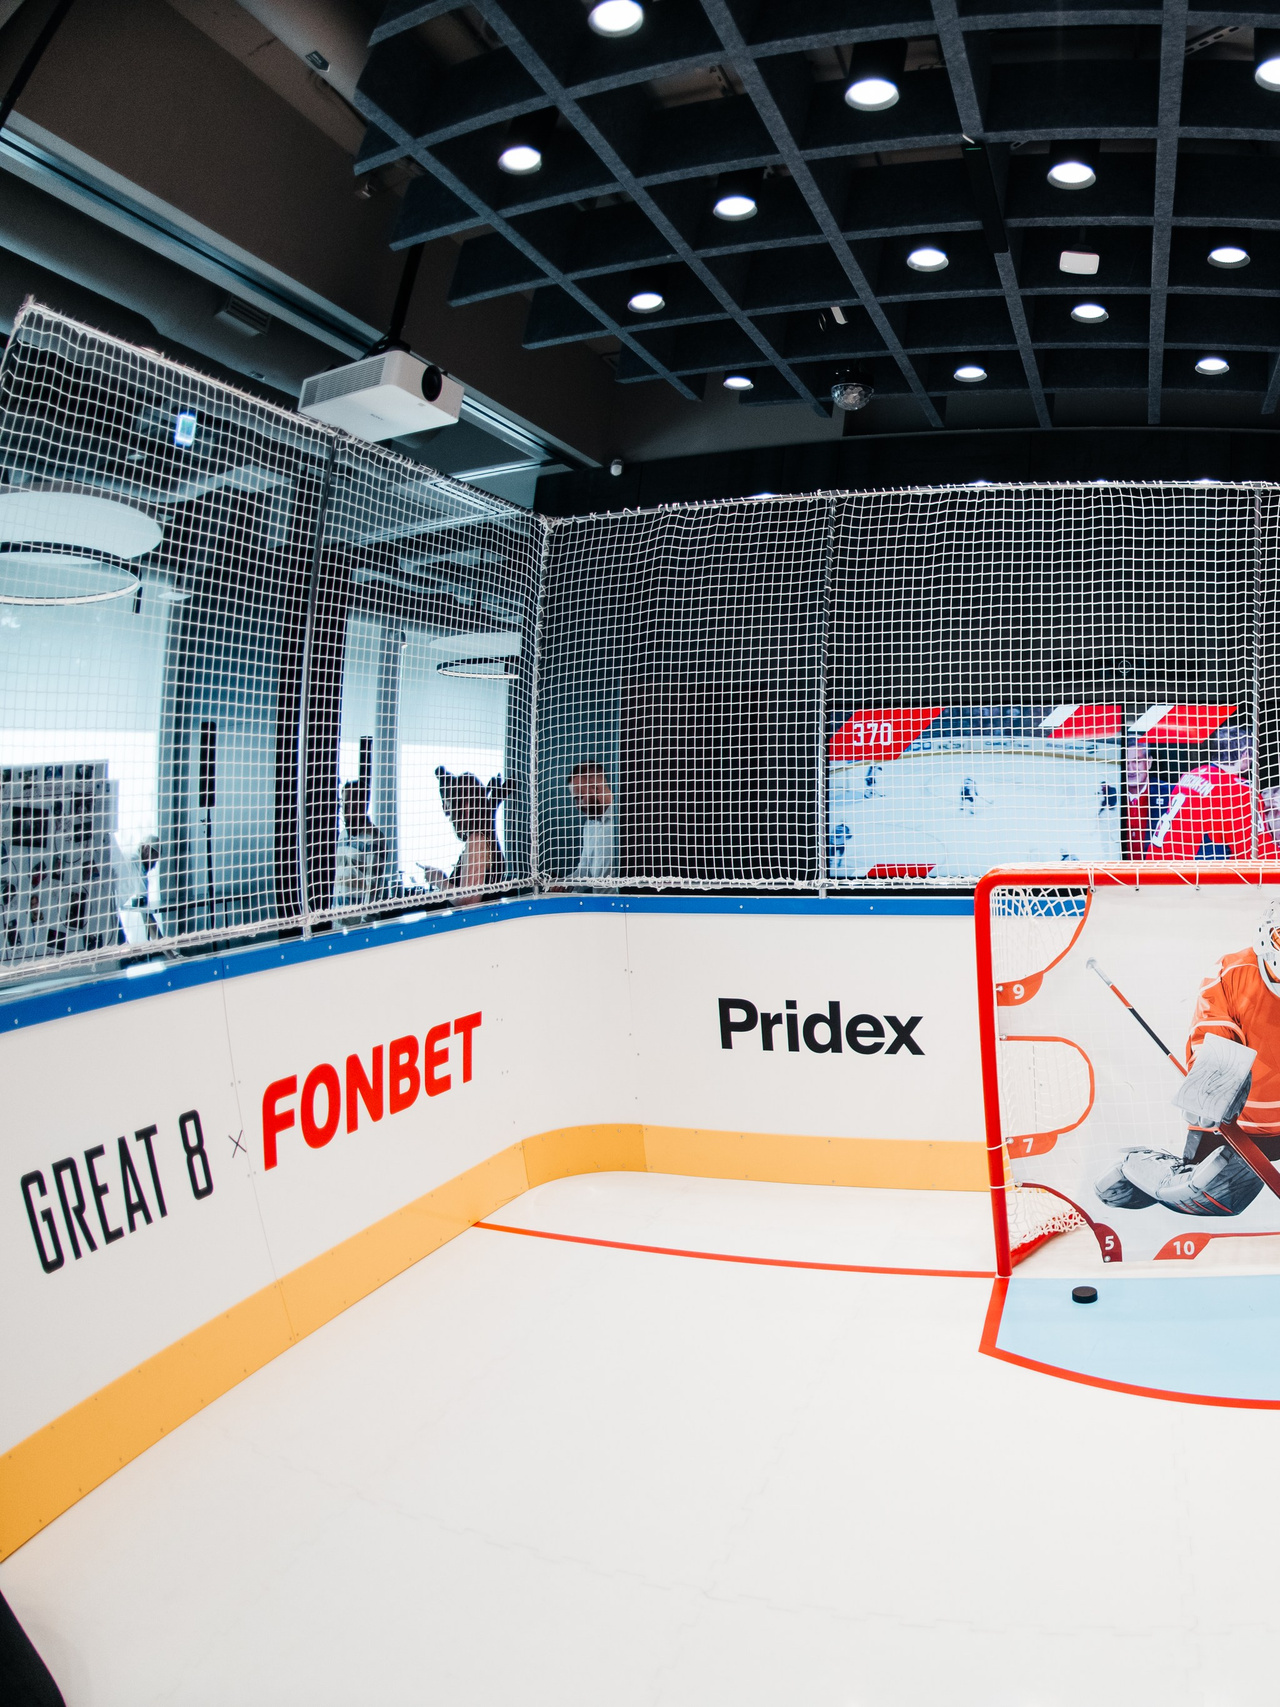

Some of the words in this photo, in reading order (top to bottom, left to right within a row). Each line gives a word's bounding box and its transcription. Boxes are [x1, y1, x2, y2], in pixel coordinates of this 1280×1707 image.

[853, 722, 892, 747] 370
[1012, 983, 1025, 1000] 9
[717, 997, 926, 1056] Pridex
[20, 1124, 168, 1275] GREAT
[178, 1109, 214, 1201] 8
[262, 1011, 482, 1171] FONBET
[1022, 1137, 1034, 1154] 7
[1104, 1235, 1115, 1251] 5
[1172, 1240, 1196, 1256] 10
